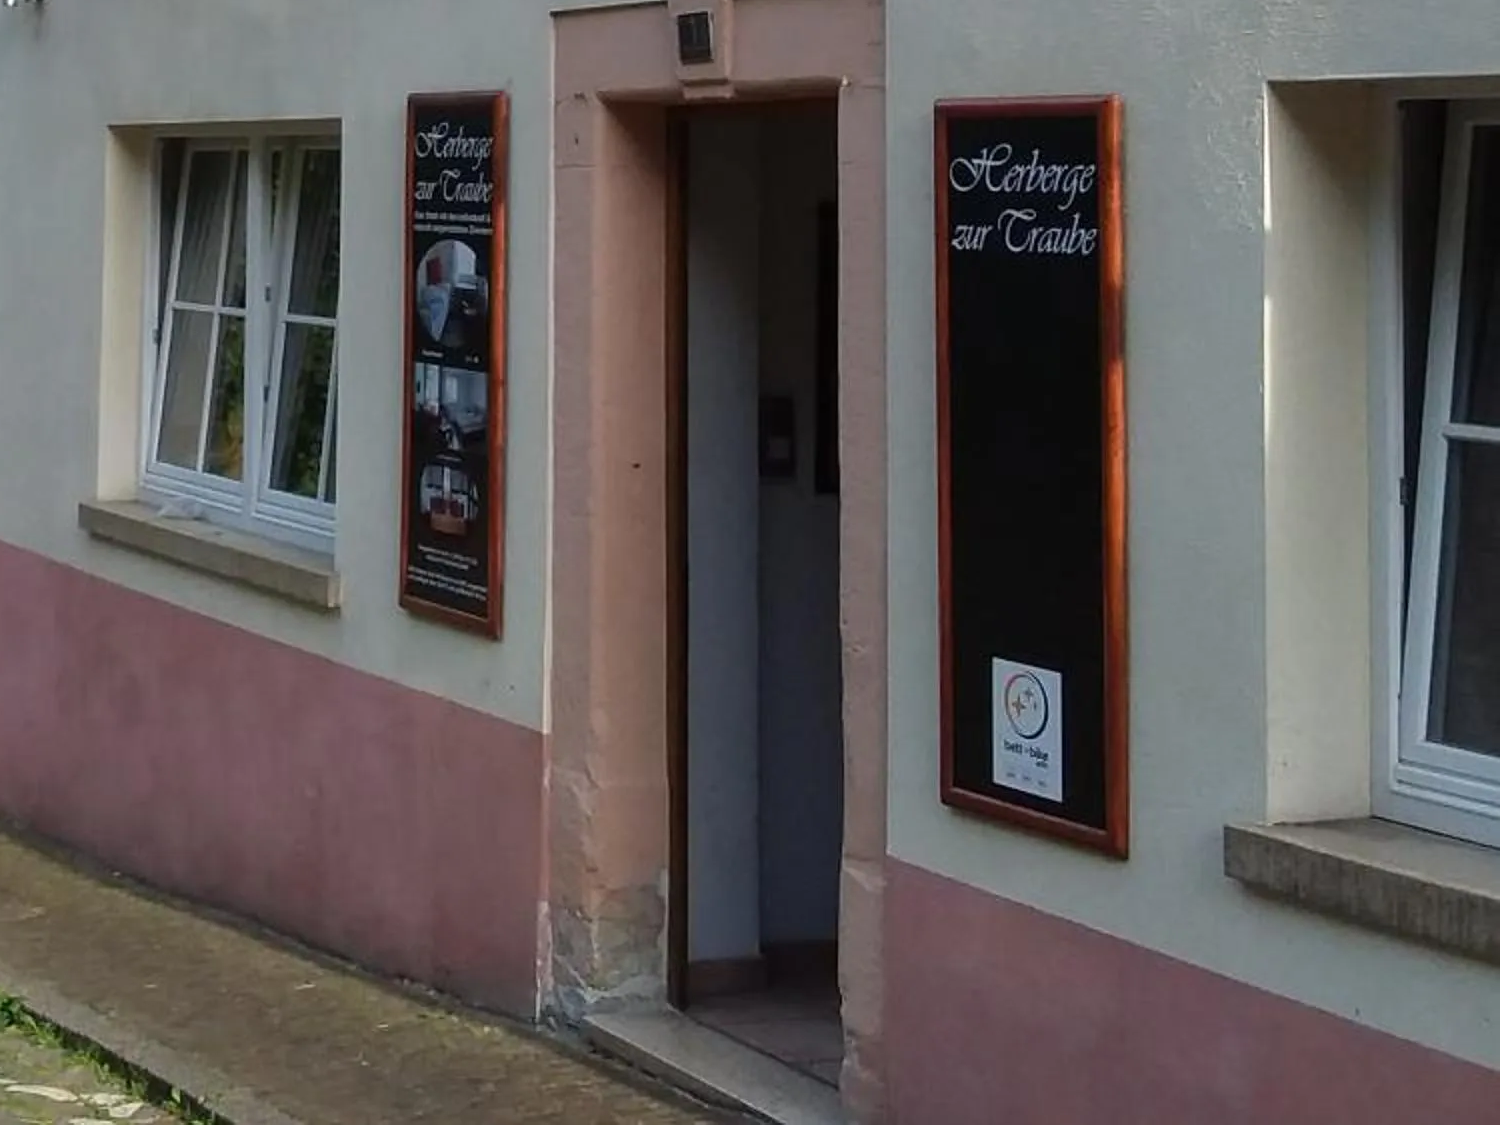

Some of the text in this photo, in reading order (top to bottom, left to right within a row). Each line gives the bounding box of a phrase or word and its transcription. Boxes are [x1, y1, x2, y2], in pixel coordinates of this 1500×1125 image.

[415, 122, 494, 171] Herberge
[439, 168, 494, 204] Traube
[950, 143, 1096, 210] Herberge
[951, 208, 1098, 255] zur Traube
